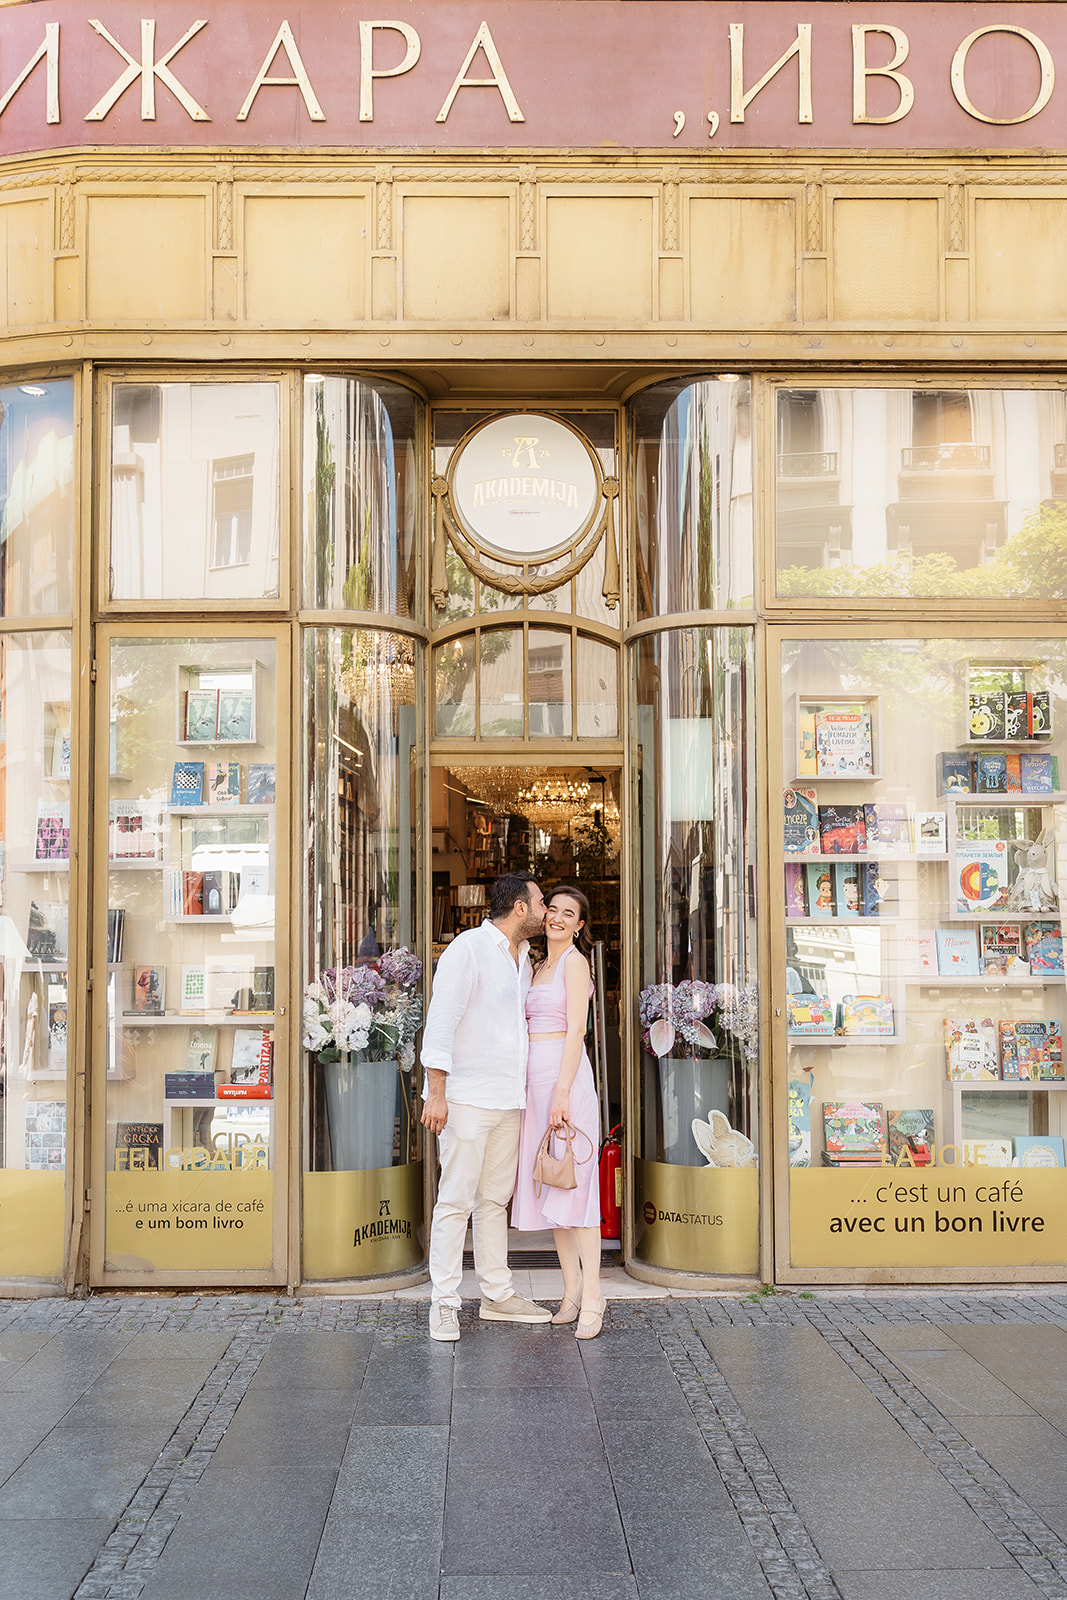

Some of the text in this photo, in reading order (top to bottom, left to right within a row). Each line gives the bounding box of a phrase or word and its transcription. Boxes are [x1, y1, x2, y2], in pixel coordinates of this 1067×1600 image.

[472, 475, 579, 509] AKADEMIJA
[123, 1131, 160, 1144] GRČKA
[127, 1125, 159, 1133] ANTIČKA
[115, 1146, 266, 1171] FELICIDADE
[881, 1143, 989, 1168] LA JOIE
[876, 1181, 929, 1203] c'est
[937, 1187, 966, 1203] un
[975, 1180, 1024, 1203] café
[138, 1202, 167, 1212] uma
[171, 1200, 211, 1212] xicara
[215, 1200, 233, 1212] de
[236, 1199, 265, 1212] café
[135, 1216, 244, 1229] e um bom livro
[658, 1210, 724, 1226] DATASTATUS
[829, 1210, 1045, 1233] avec un bon livre
[353, 1218, 412, 1247] AKADEMIJA
